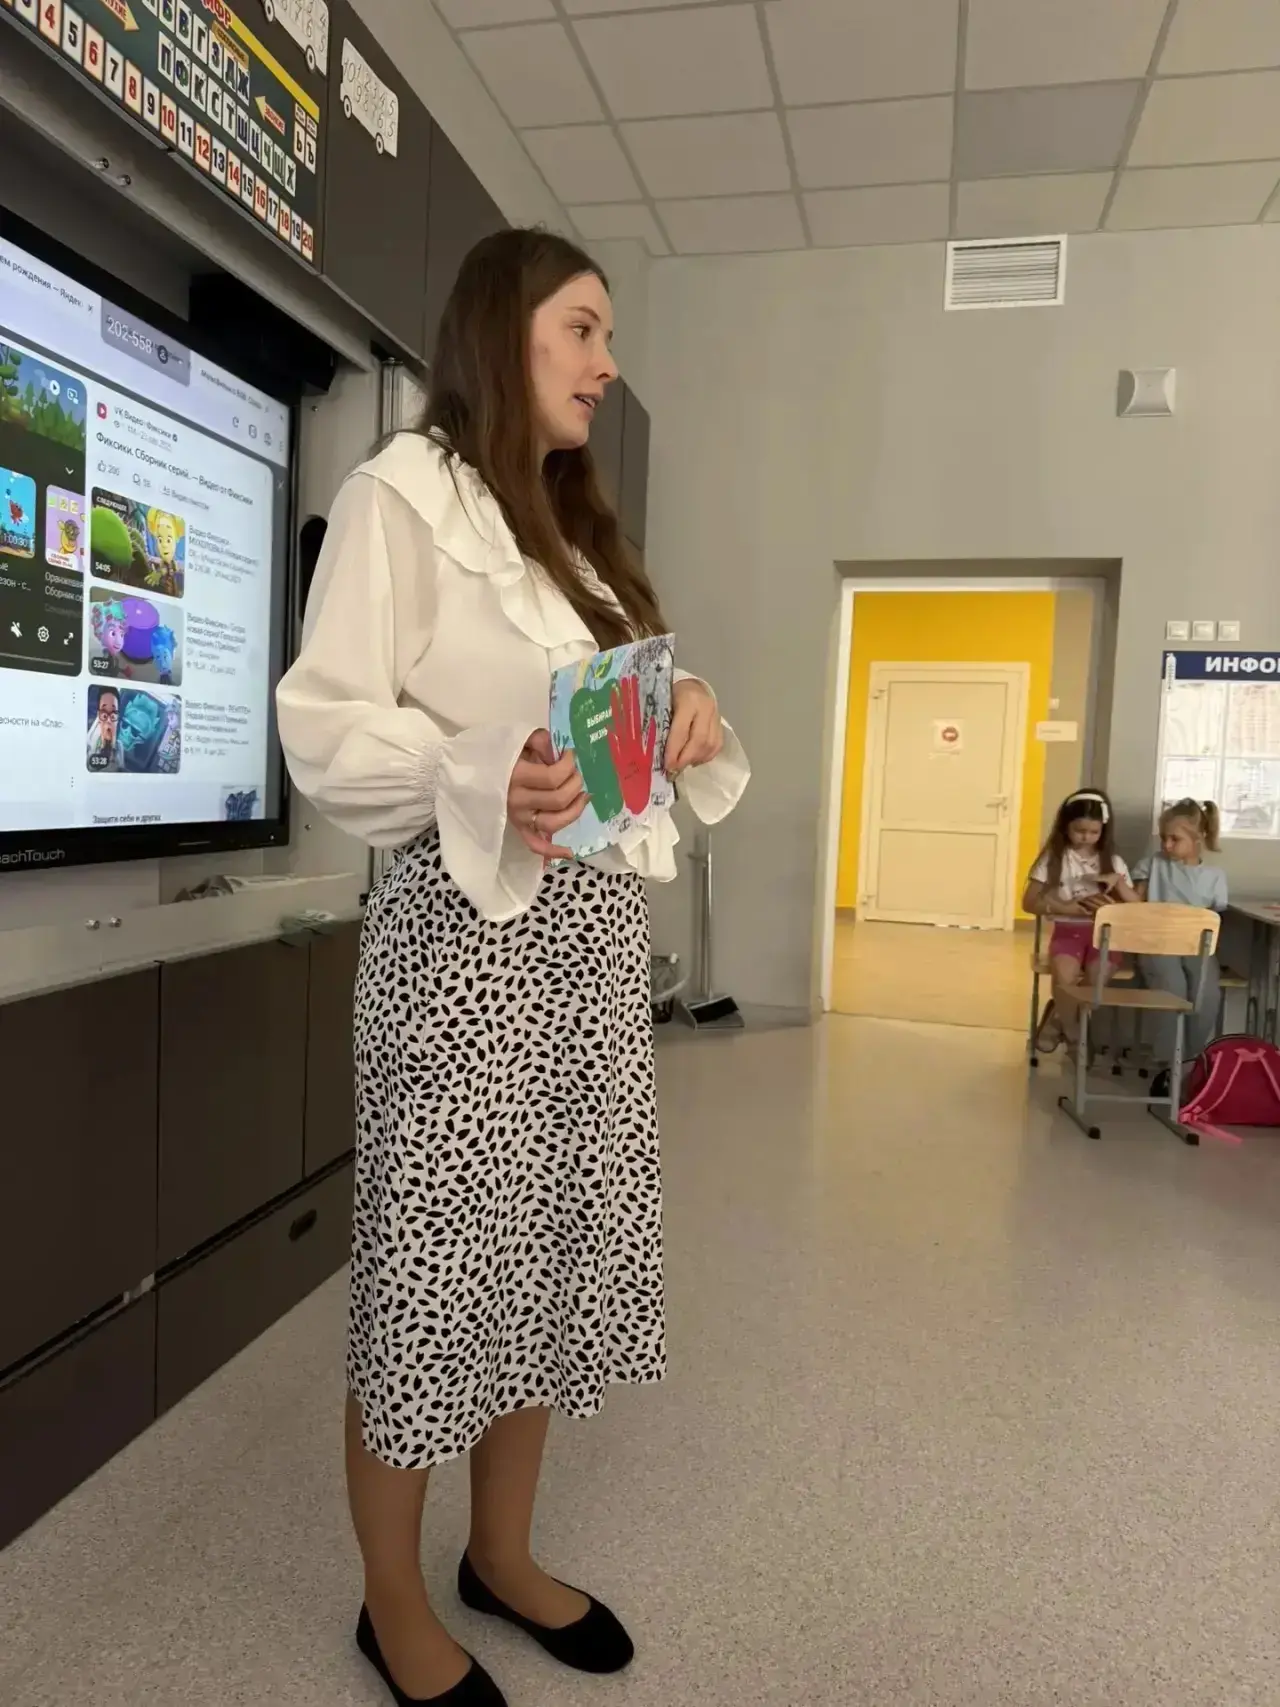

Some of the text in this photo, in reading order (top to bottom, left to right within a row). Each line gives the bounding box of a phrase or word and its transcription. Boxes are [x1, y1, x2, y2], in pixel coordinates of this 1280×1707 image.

[306, 19, 312, 37] 6
[179, 8, 189, 38] В
[197, 26, 206, 53] Г
[212, 41, 220, 68] З
[238, 68, 249, 100] Ж
[344, 58, 356, 83] 10
[389, 100, 396, 116] 5
[161, 43, 171, 76] П
[176, 60, 189, 87] Ф
[194, 74, 205, 105] К
[211, 91, 220, 118] С
[226, 102, 235, 130] Т
[238, 114, 248, 145] Ш
[251, 127, 260, 160] Ц
[263, 141, 271, 168] Ч
[286, 164, 295, 191] Х
[356, 85, 362, 103] 9
[388, 121, 396, 137] 5
[45, 4, 313, 252] 4 5 6 7 8 9 10 11 12 13 14 15 16 17 18 19 20
[306, 141, 314, 165] Ъ
[12, 262, 52, 290] рождения
[107, 316, 152, 354] 202-558
[135, 448, 168, 469] Сборник
[95, 561, 111, 573] 54:05
[93, 659, 109, 669] 53:27
[1205, 656, 1280, 674] ИНФО
[31, 717, 40, 727] на
[586, 705, 612, 729] ВЫБИРАЙ
[590, 727, 608, 744] ЖИЗНЬ
[0, 849, 66, 864] achTouch
